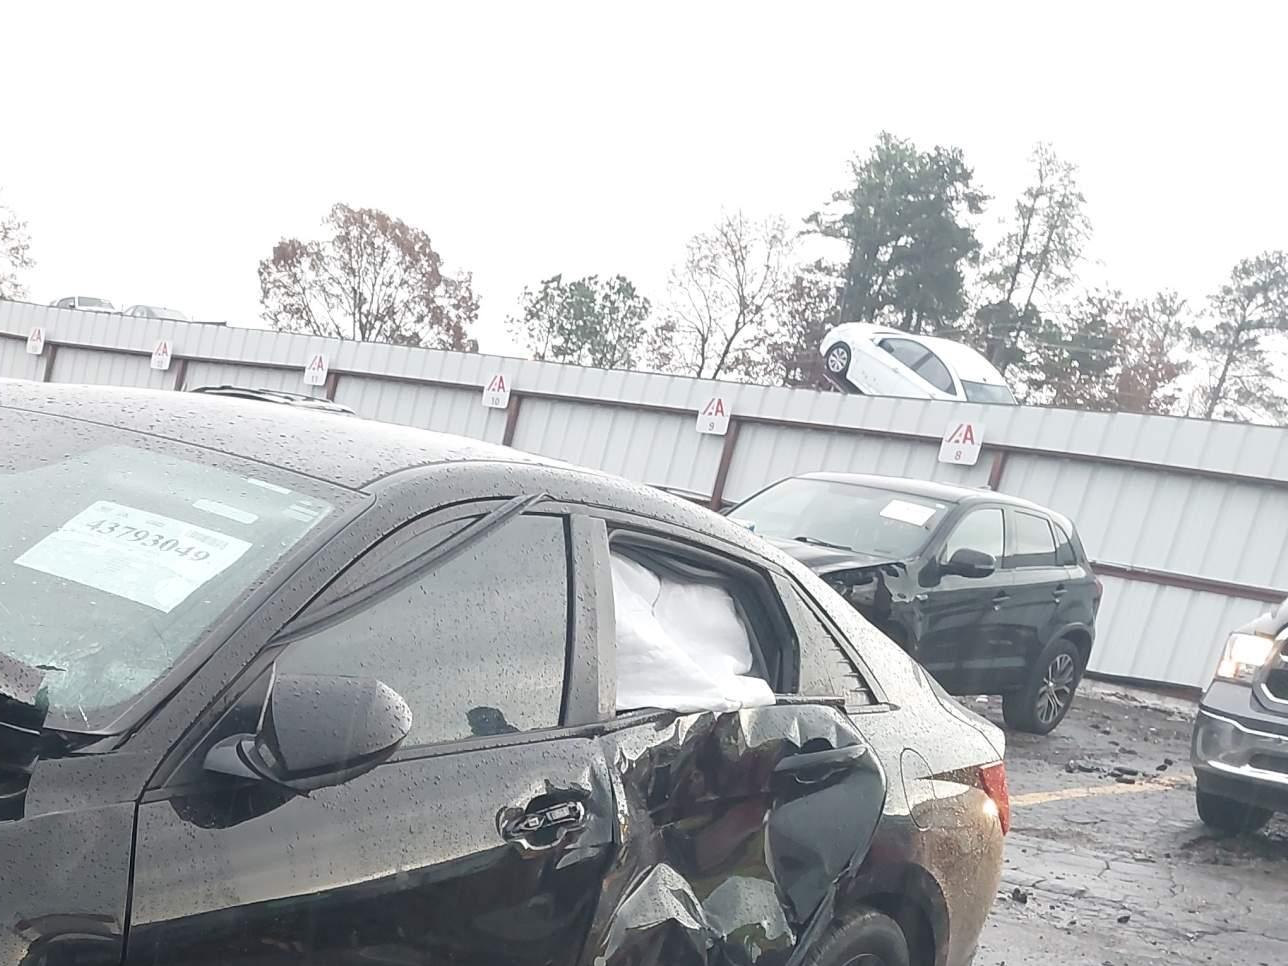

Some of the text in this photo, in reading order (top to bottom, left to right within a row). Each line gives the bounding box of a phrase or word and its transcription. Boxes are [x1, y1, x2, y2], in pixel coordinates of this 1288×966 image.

[707, 422, 715, 432] 9
[954, 449, 963, 461] 8
[86, 518, 211, 562] 43793049
